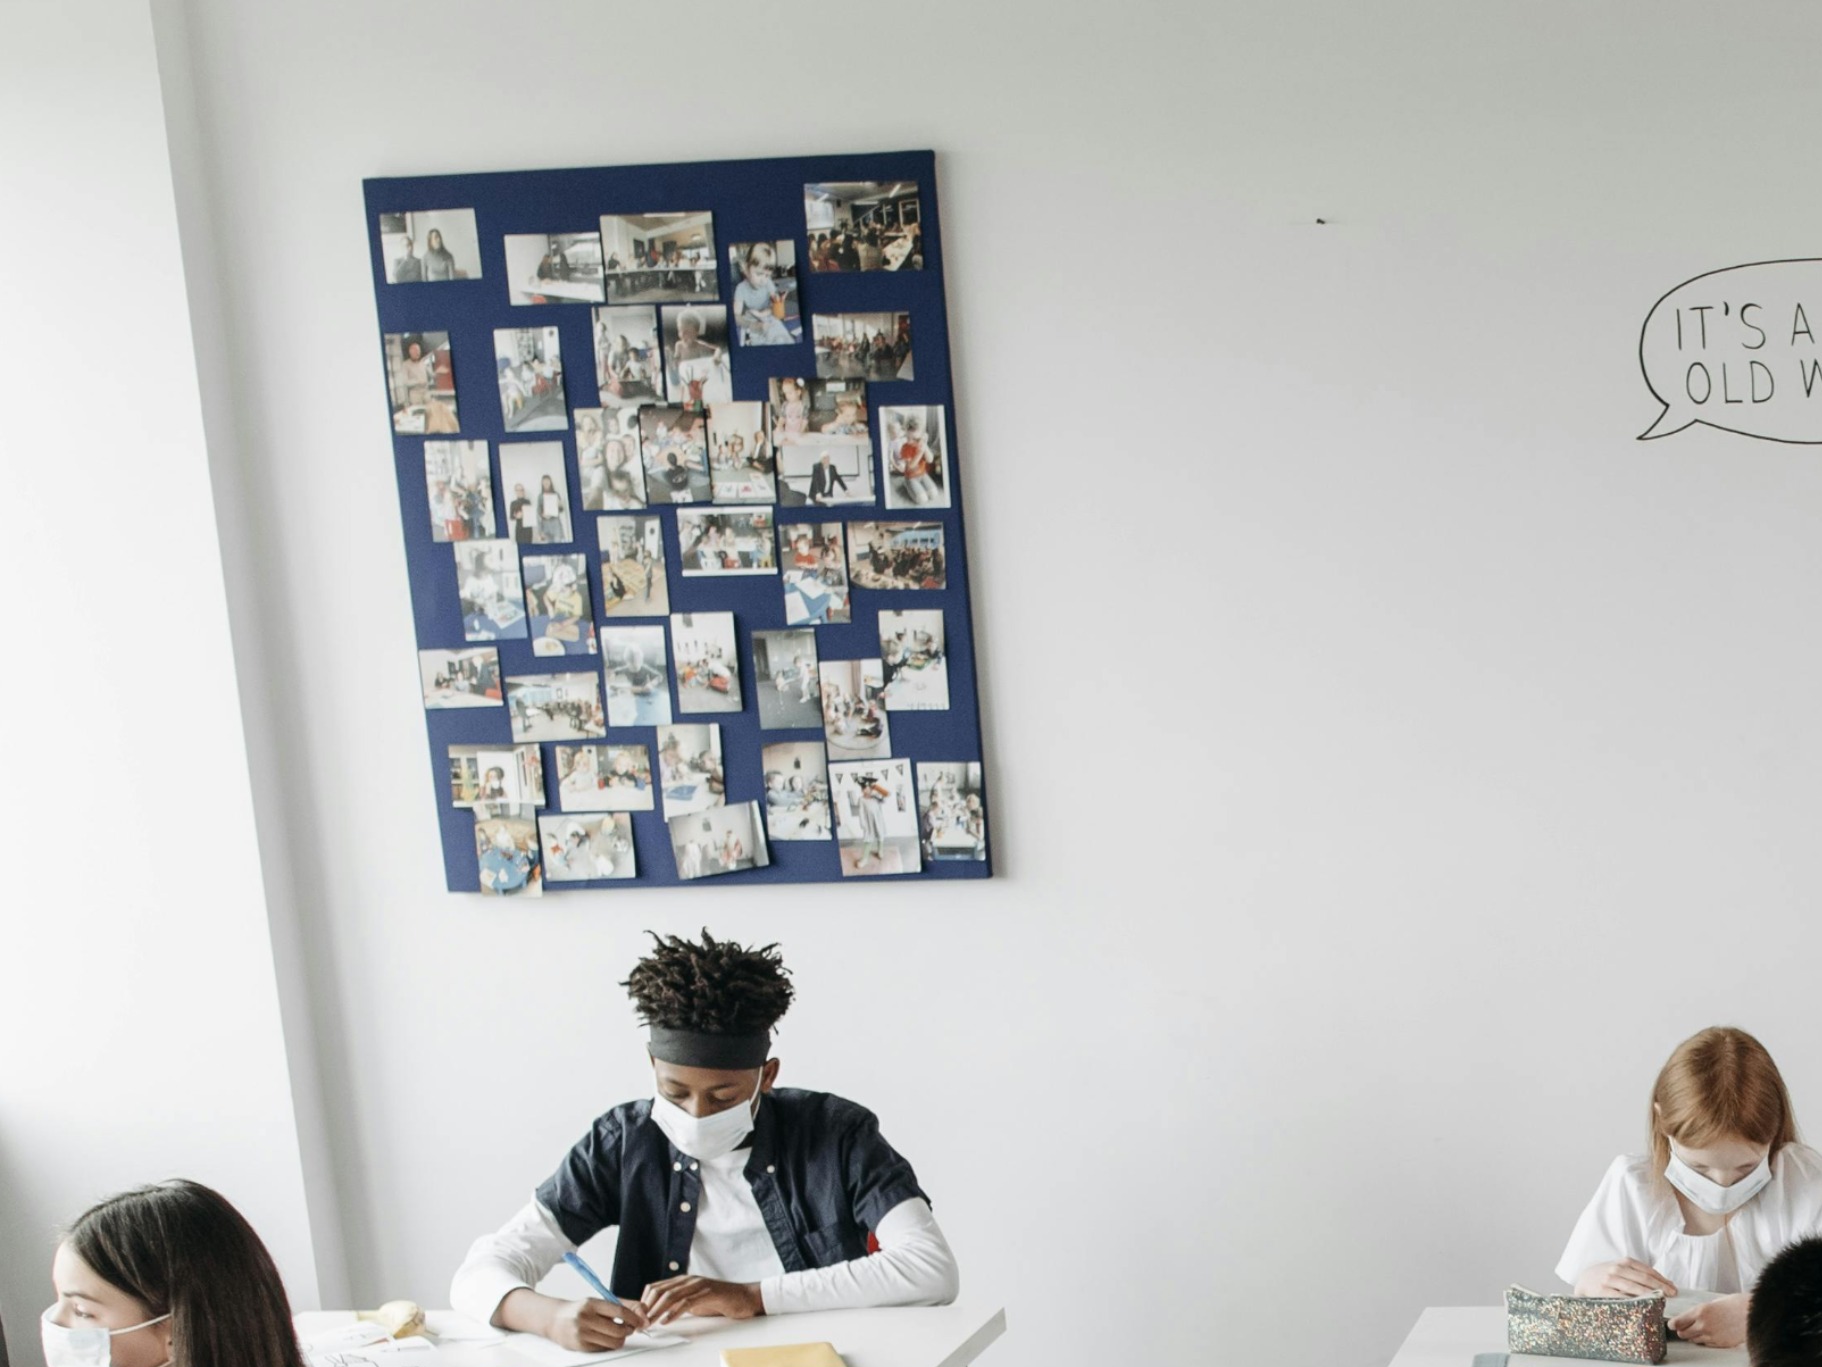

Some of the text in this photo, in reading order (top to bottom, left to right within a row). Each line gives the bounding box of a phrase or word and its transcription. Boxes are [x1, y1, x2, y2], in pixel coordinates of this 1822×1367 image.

[1675, 300, 1767, 351] IT'S
[1791, 302, 1816, 346] A
[1685, 360, 1775, 405] OLD
